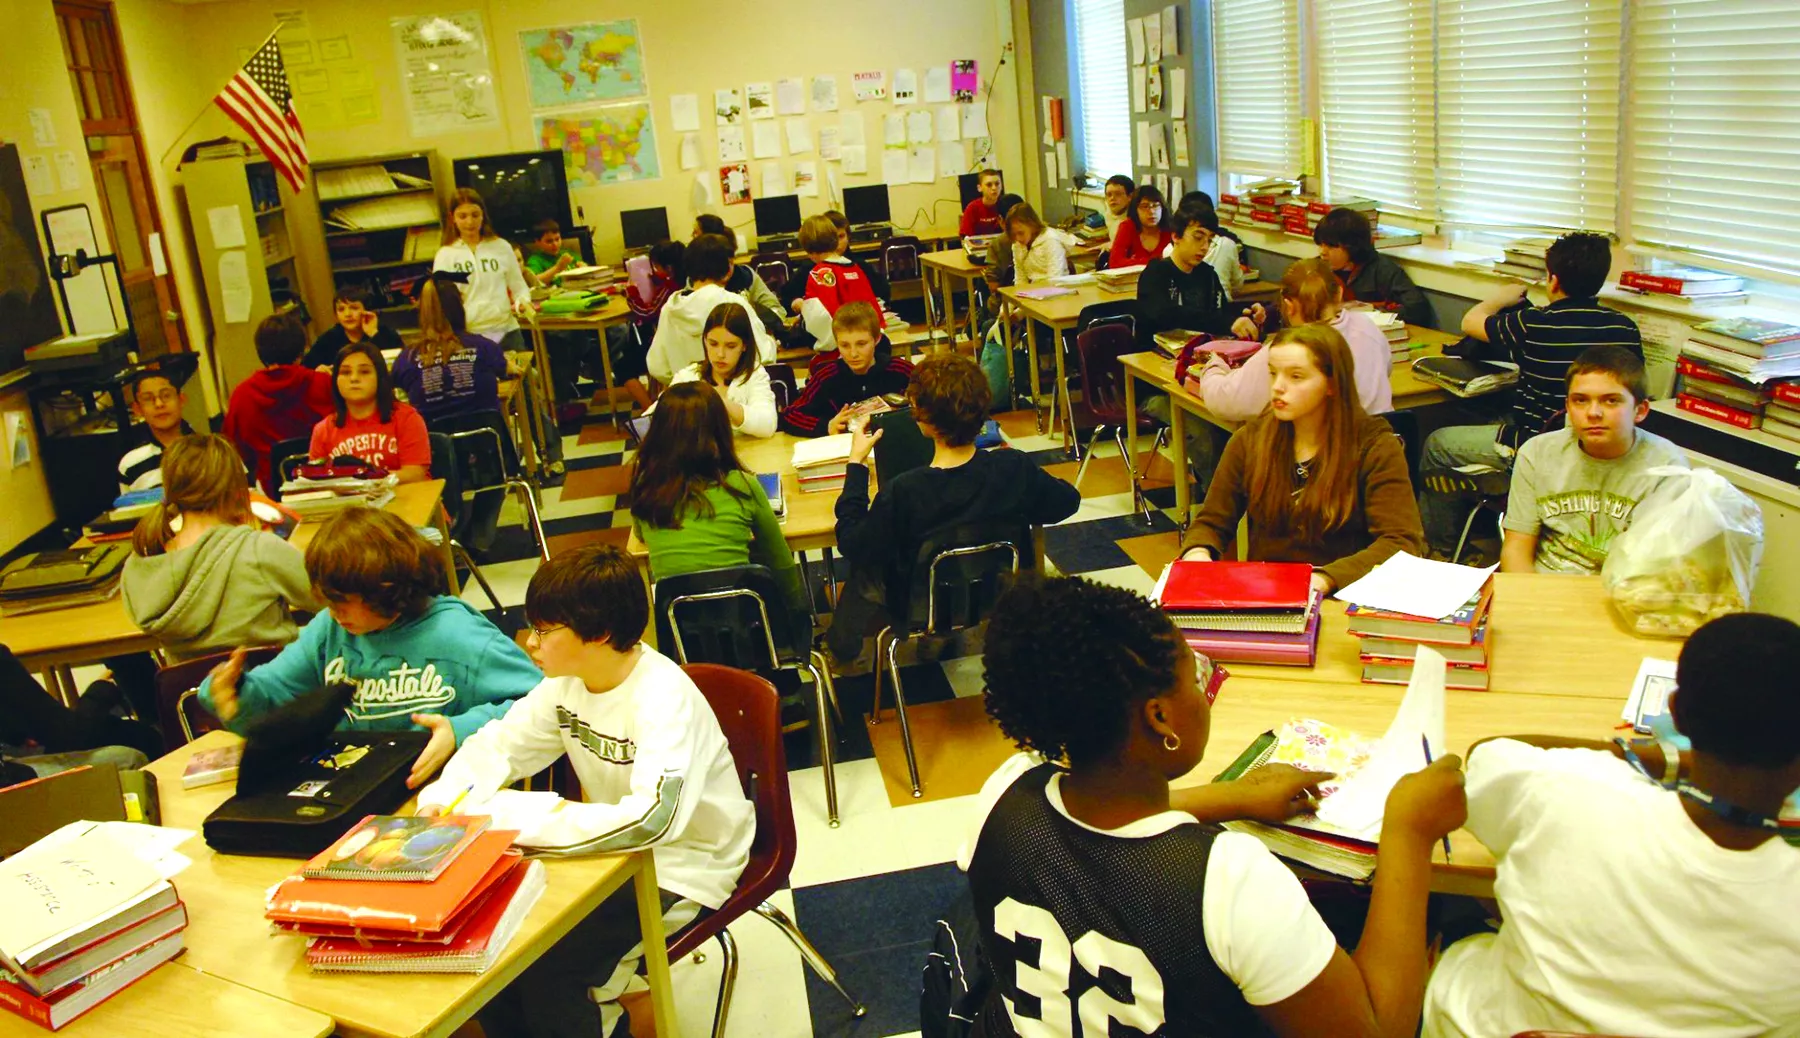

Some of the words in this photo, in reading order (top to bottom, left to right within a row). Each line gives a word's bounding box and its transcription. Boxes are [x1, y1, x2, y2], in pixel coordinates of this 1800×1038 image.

[1542, 490, 1600, 518] ISHING
[602, 739, 637, 761] NI
[994, 896, 1166, 1038] 32
